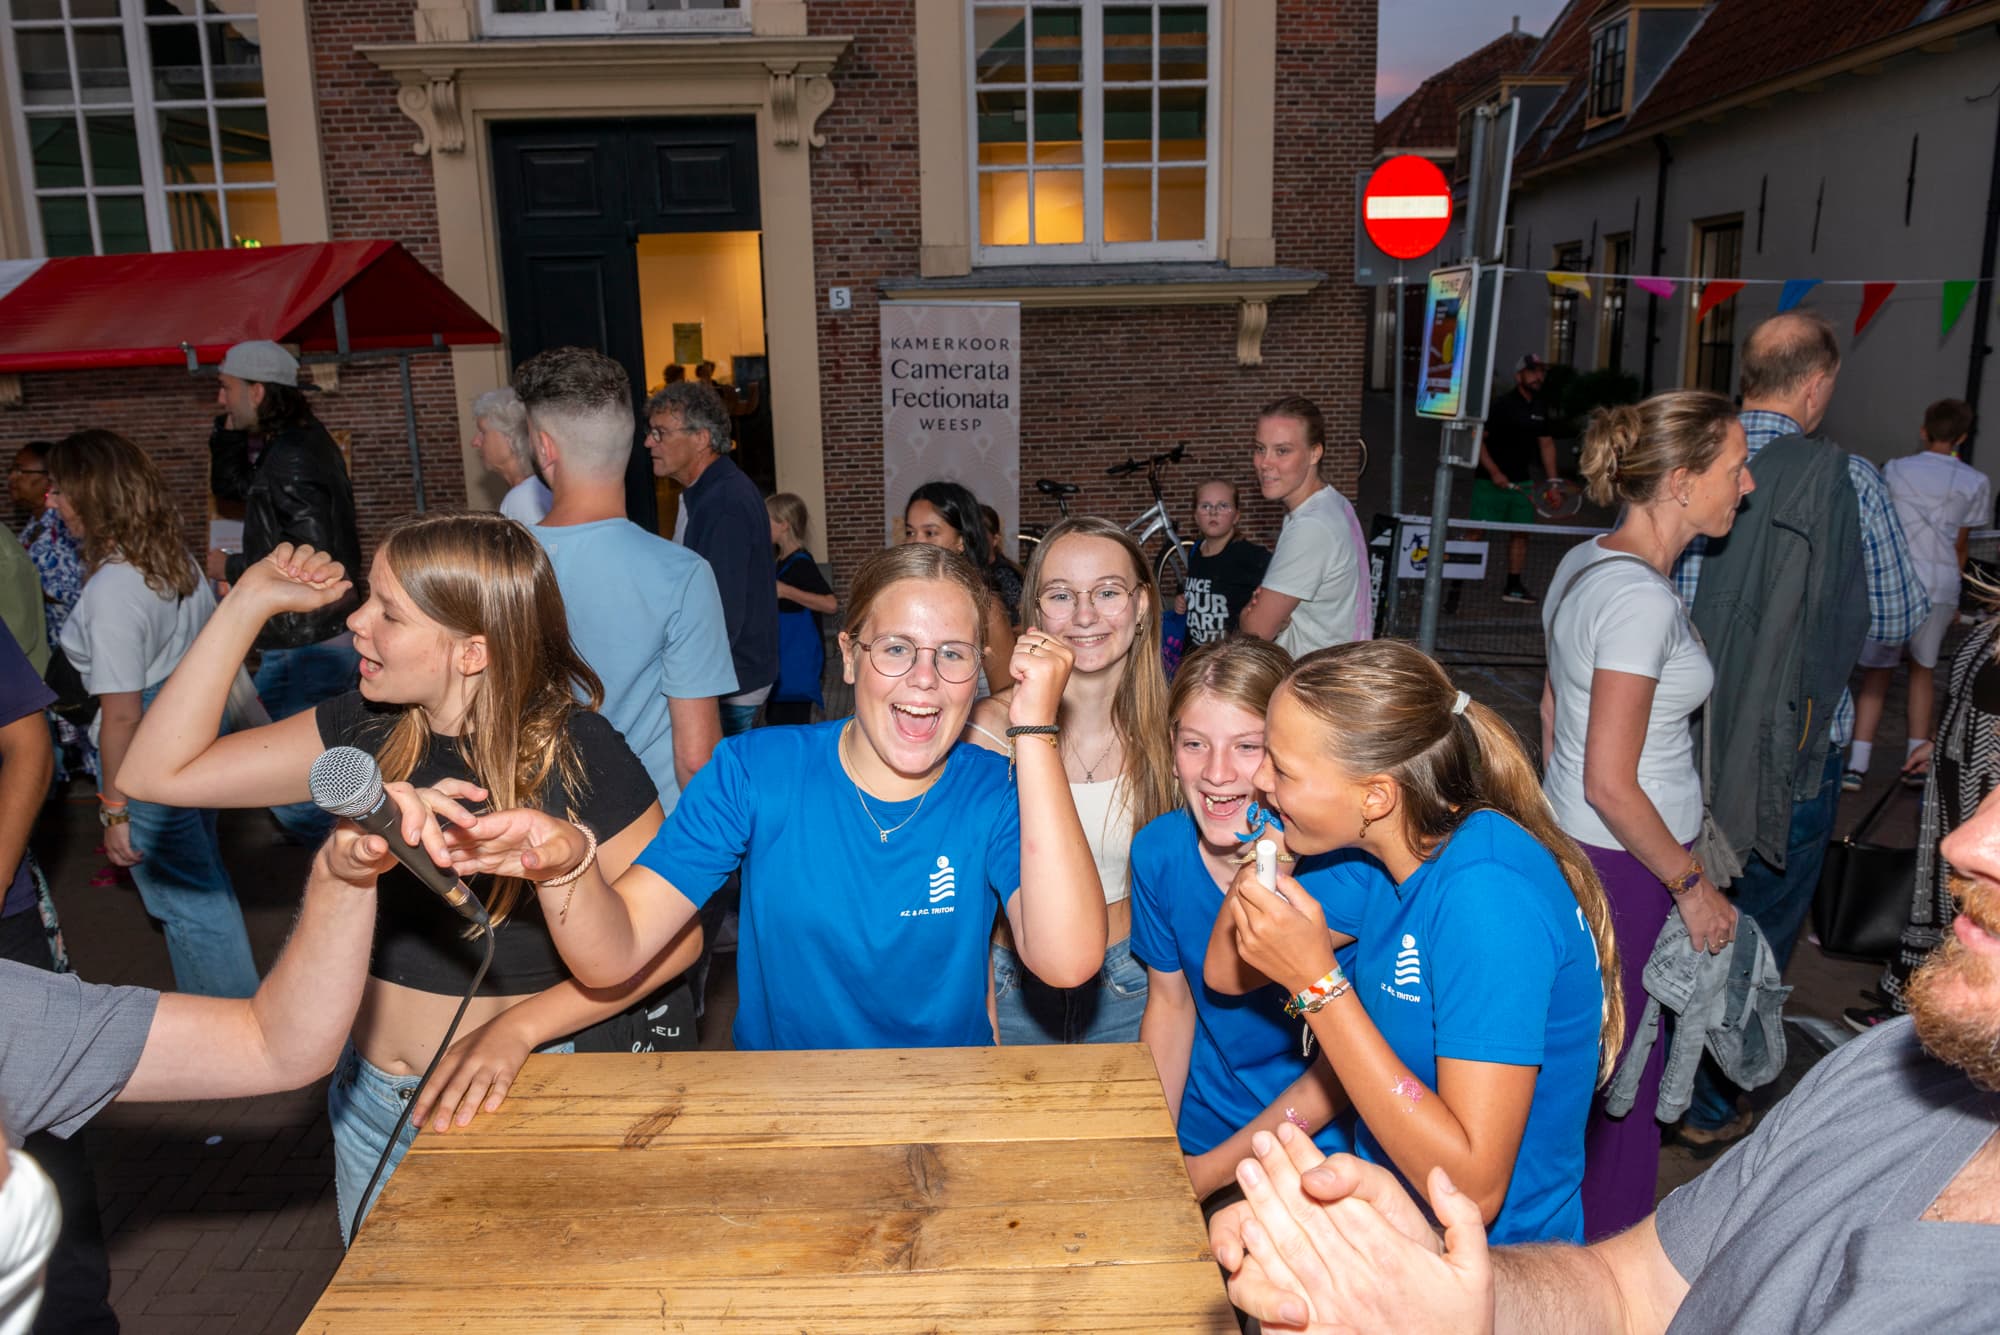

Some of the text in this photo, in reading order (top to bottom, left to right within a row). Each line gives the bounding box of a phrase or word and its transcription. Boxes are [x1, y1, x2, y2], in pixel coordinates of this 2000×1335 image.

[835, 290, 845, 307] 5
[891, 338, 1010, 350] KAMERKOOR
[891, 358, 1010, 380] Camerata
[891, 386, 1010, 409] Fectionata
[919, 418, 982, 431] WEESP
[931, 905, 955, 915] TRITON
[1396, 991, 1421, 1003] TRITON
